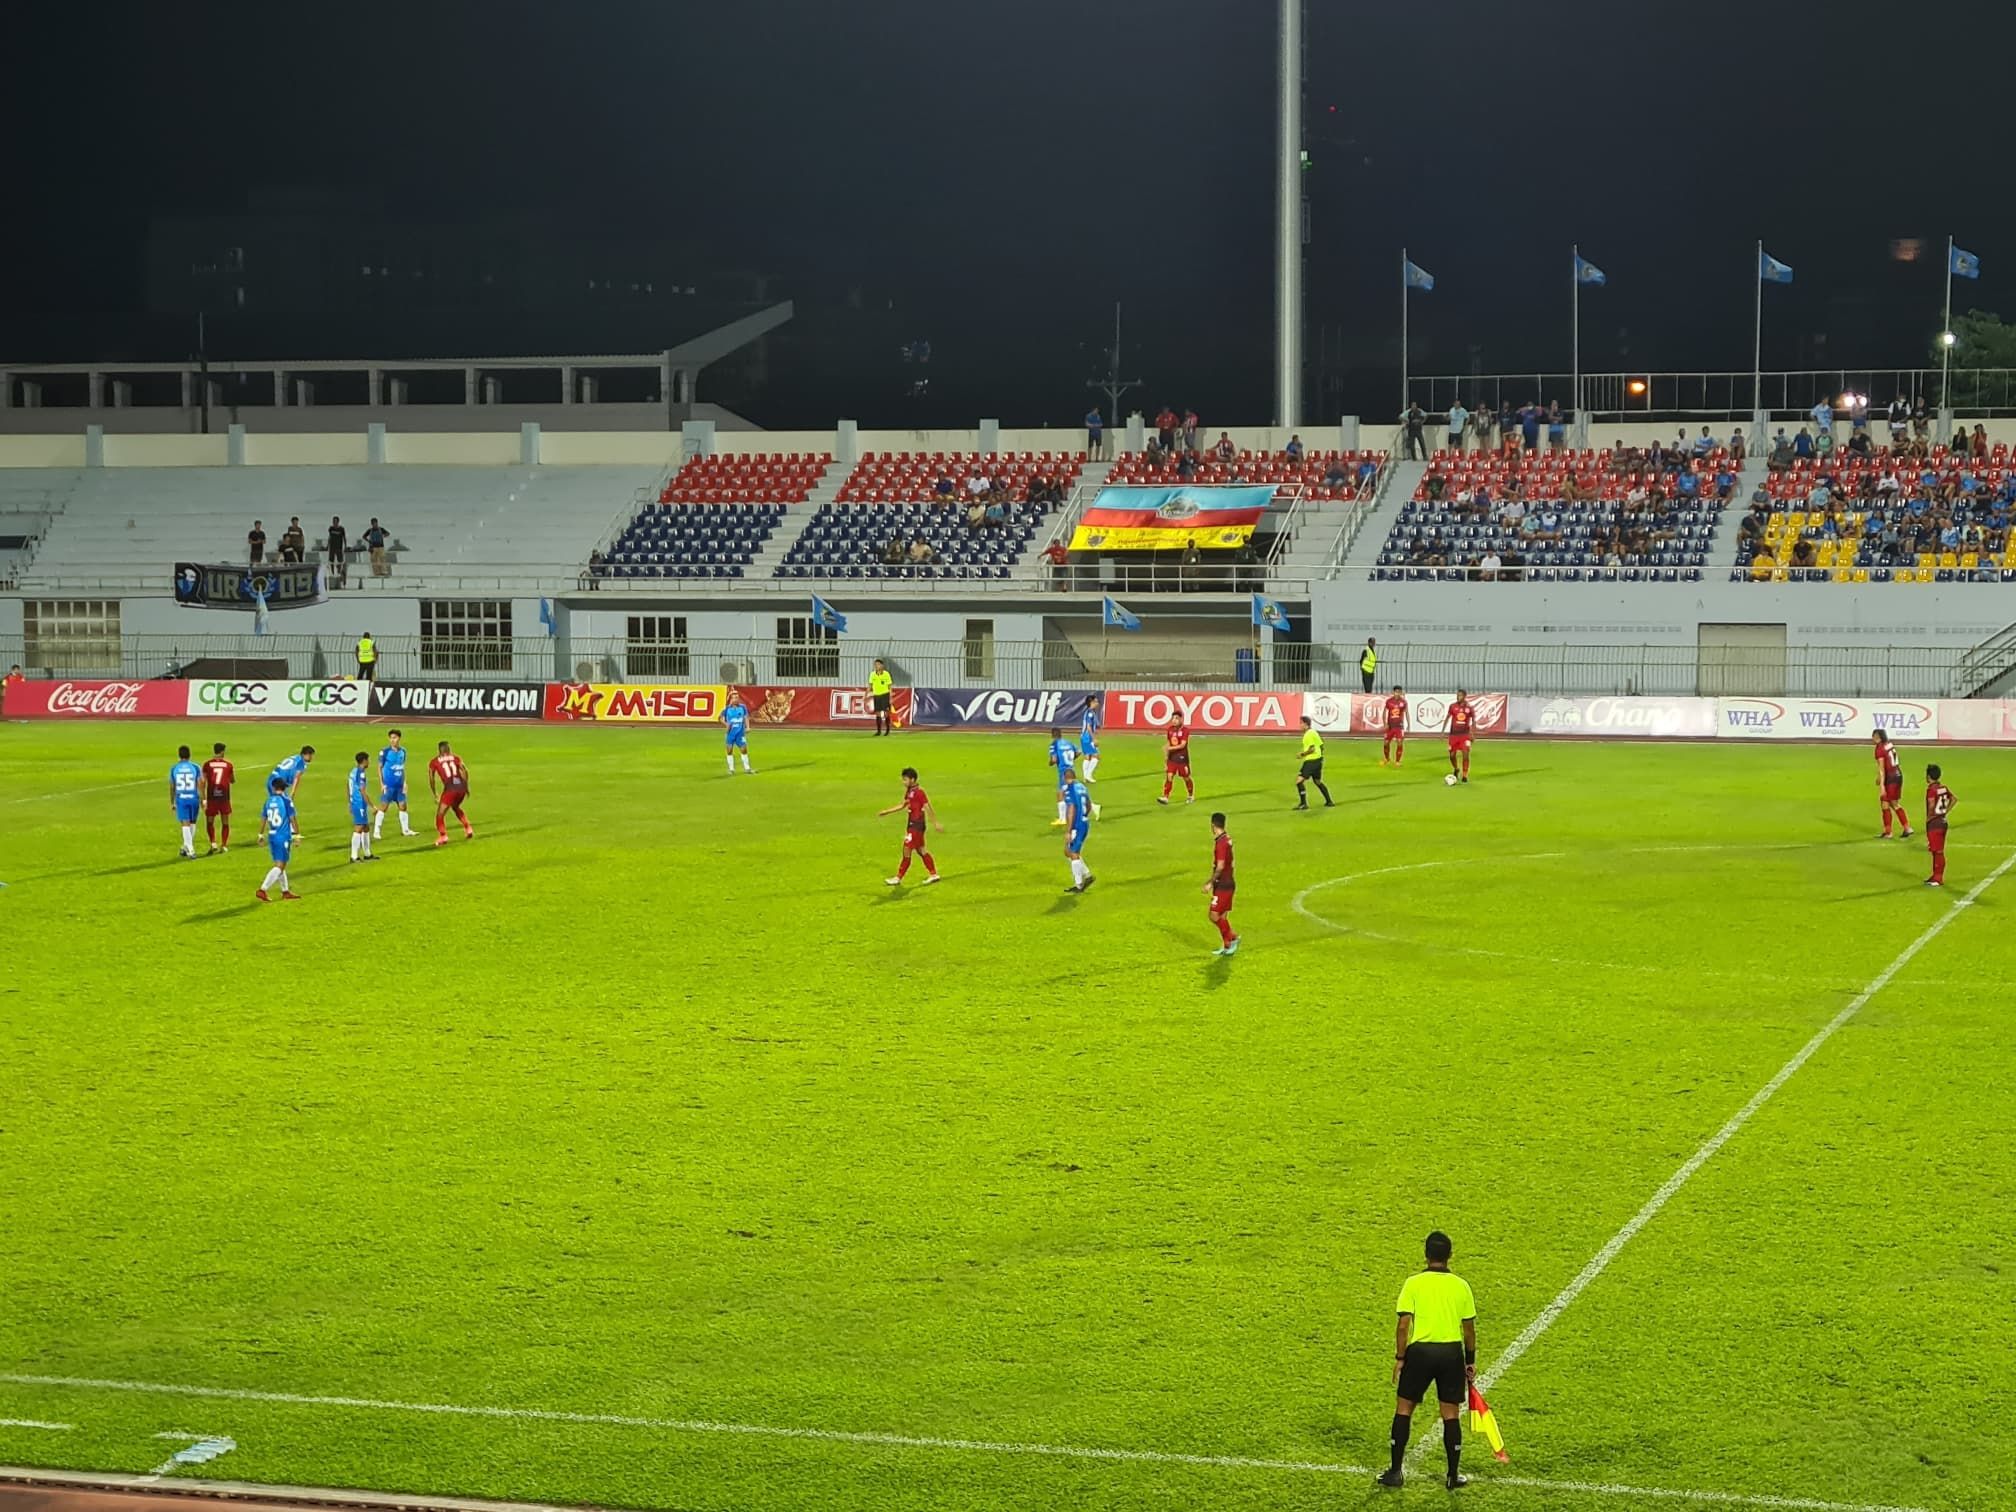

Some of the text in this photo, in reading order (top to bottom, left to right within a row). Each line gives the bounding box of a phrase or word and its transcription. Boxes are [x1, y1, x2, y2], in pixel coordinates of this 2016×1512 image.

[400, 687, 538, 711] VOLTBKK.COM
[606, 690, 714, 717] M-150
[986, 690, 1062, 723] Gulf
[1119, 694, 1287, 727] TOYOTA
[1727, 710, 1773, 726] WHA
[1800, 711, 1846, 727] WHA
[1872, 713, 1920, 728] WHA
[213, 767, 223, 785] 7
[442, 761, 457, 778] 11
[176, 773, 195, 791] 55
